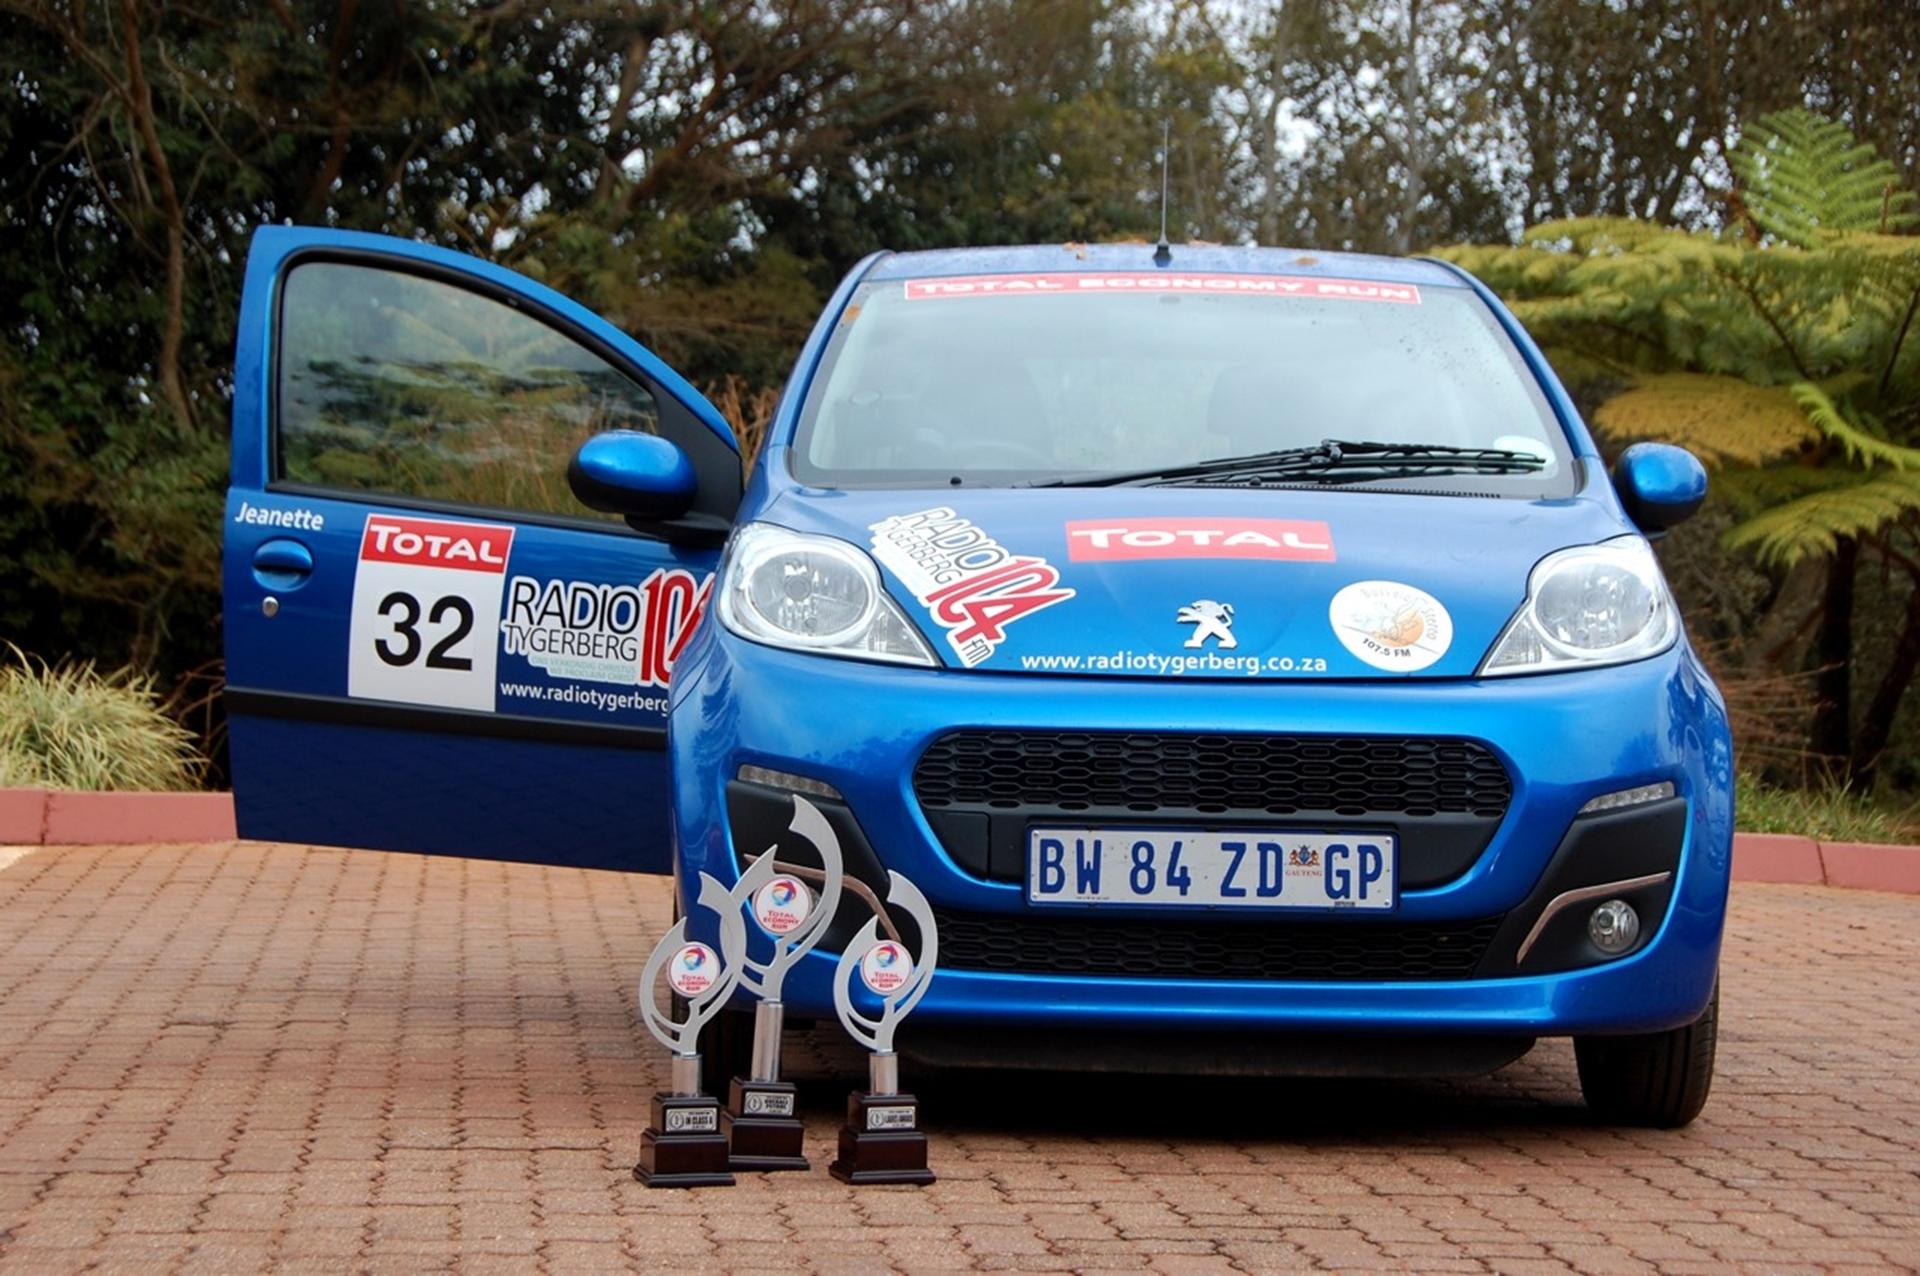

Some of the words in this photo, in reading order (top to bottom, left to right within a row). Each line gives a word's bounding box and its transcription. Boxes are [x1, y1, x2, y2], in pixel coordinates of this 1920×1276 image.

[914, 279, 1066, 293] TOTAL
[1078, 278, 1304, 291] ECONOMY
[1317, 284, 1410, 298] RUN
[235, 502, 324, 531] Jeanette
[369, 524, 504, 564] TOTAL
[901, 509, 1005, 571] RADIO
[1071, 528, 1329, 550] TOTAL
[510, 580, 641, 635] RADIO
[925, 559, 1071, 645] 104
[374, 591, 474, 671] 32
[504, 624, 638, 662] TYGERBERG
[1362, 638, 1391, 656] 107.5
[1394, 648, 1412, 657] FM
[1021, 651, 1327, 675] www.radiotygerberg.co.za
[1038, 838, 1102, 895] BW
[1129, 840, 1192, 897] 84
[1219, 842, 1284, 899] ZD
[1285, 869, 1322, 877] GAUTENG
[1324, 843, 1383, 900] GP
